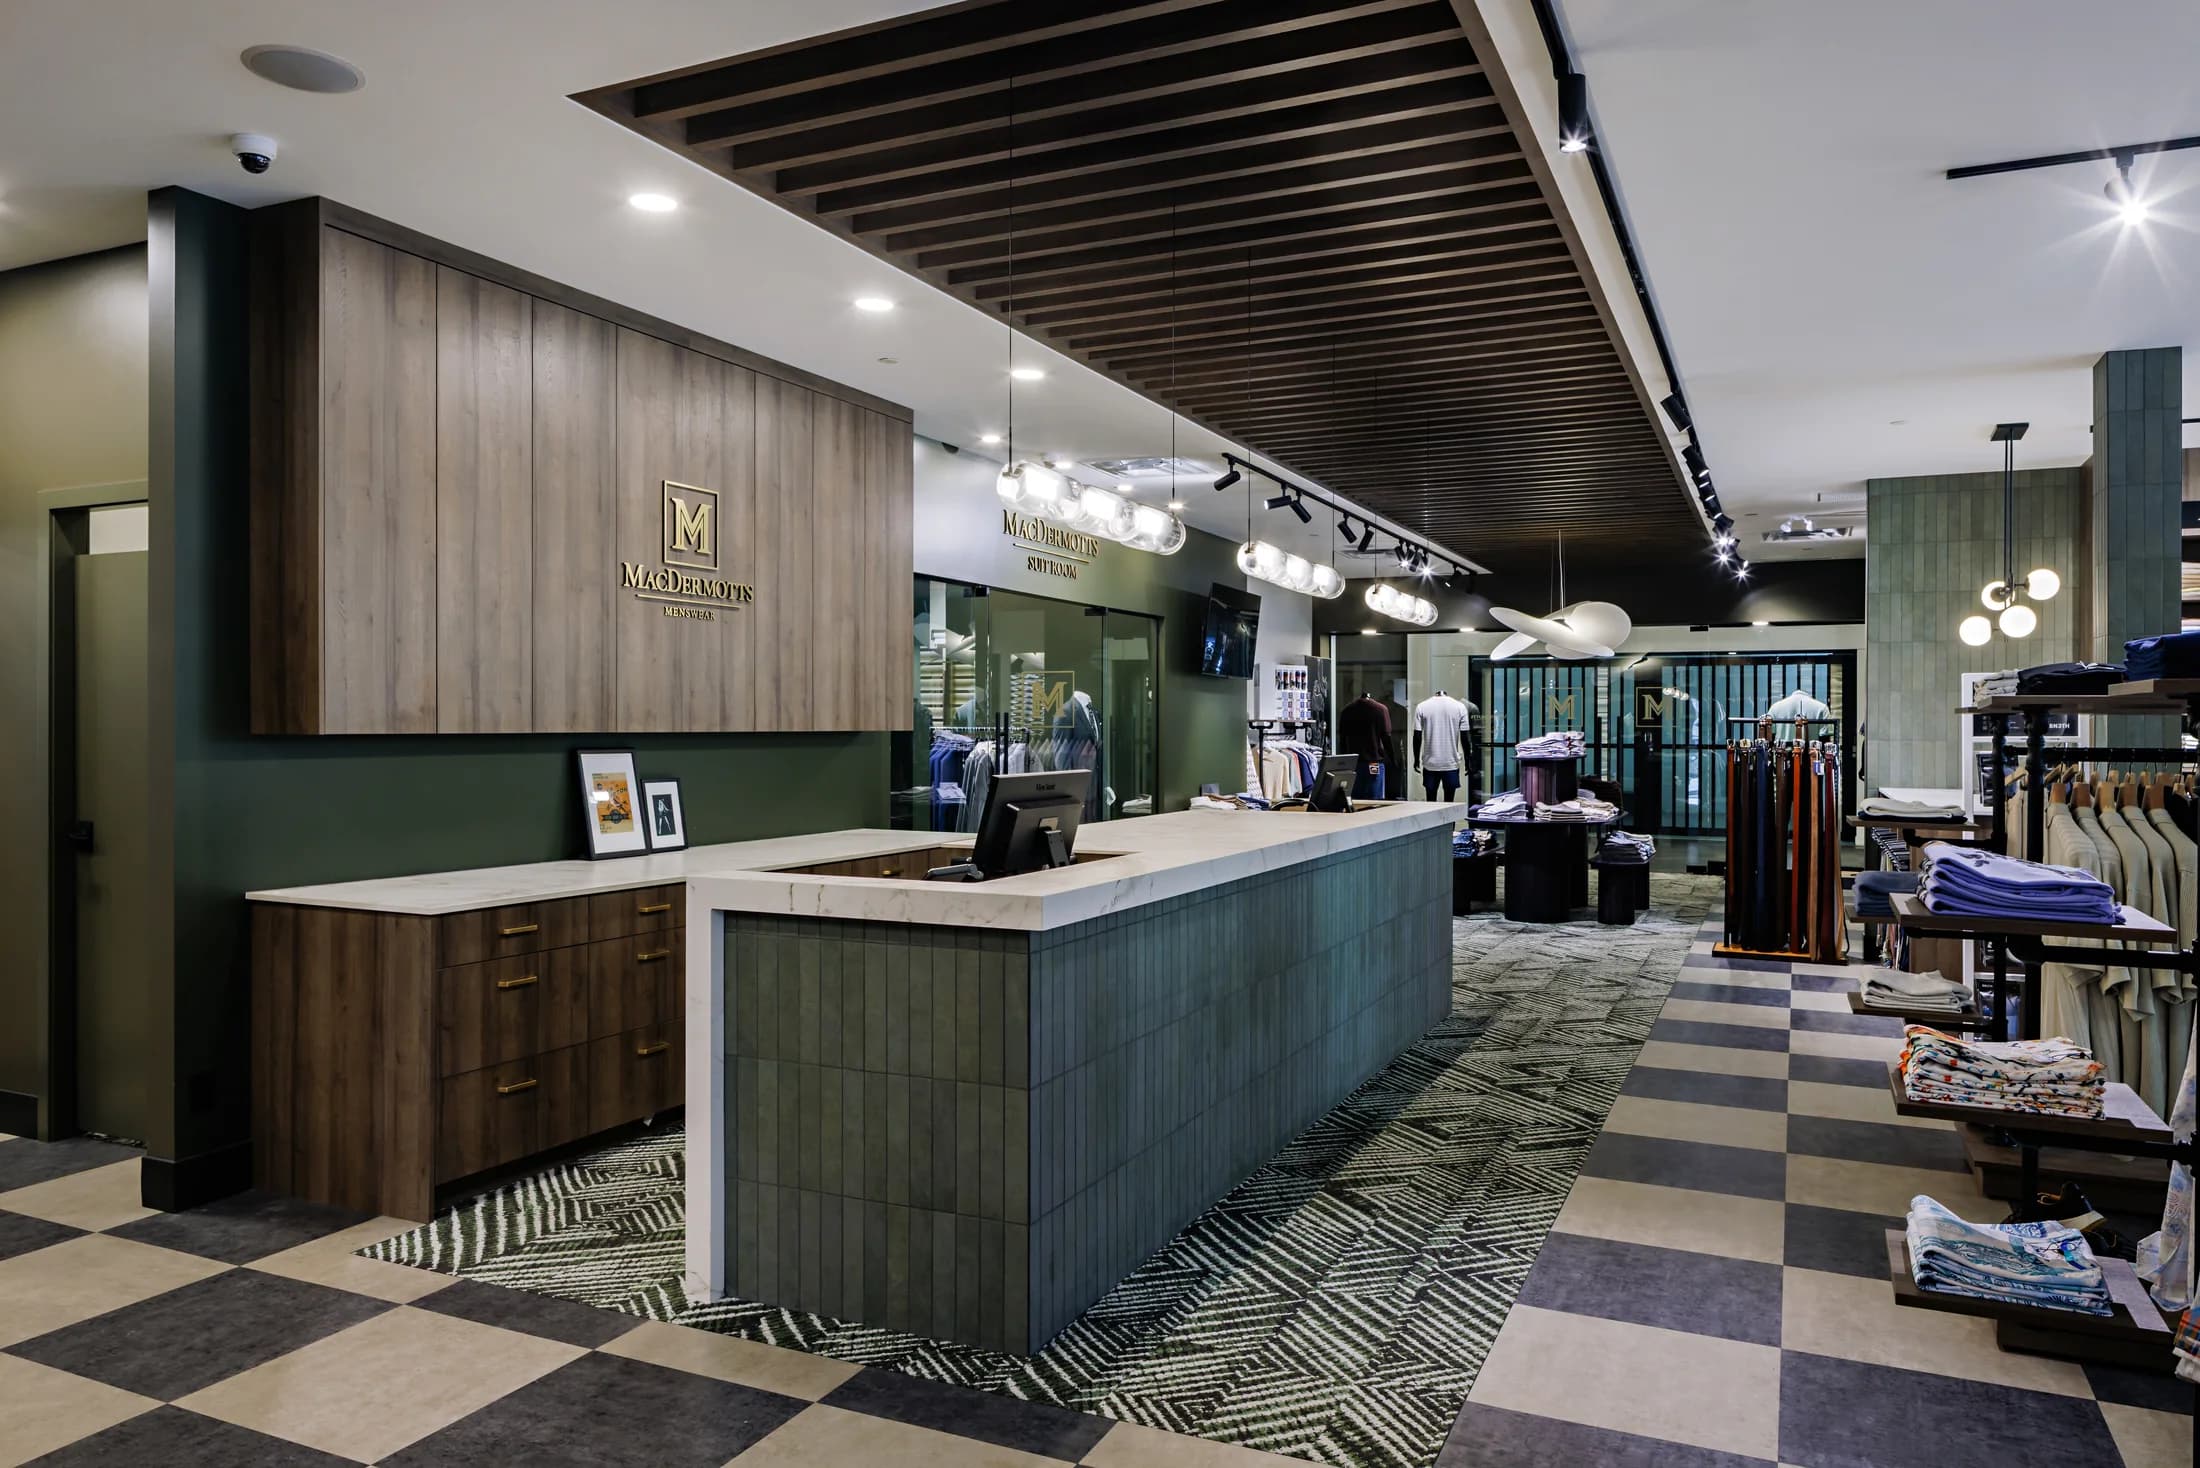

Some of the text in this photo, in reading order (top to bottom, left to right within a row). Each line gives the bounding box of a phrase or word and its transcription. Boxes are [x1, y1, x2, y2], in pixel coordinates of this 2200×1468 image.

[670, 497, 712, 555] M
[1027, 556, 1077, 580] SUIT ROOM
[664, 605, 715, 621] MENSWEAR
[1031, 681, 1067, 718] M
[1549, 694, 1577, 720] M
[1641, 694, 1674, 720] M
